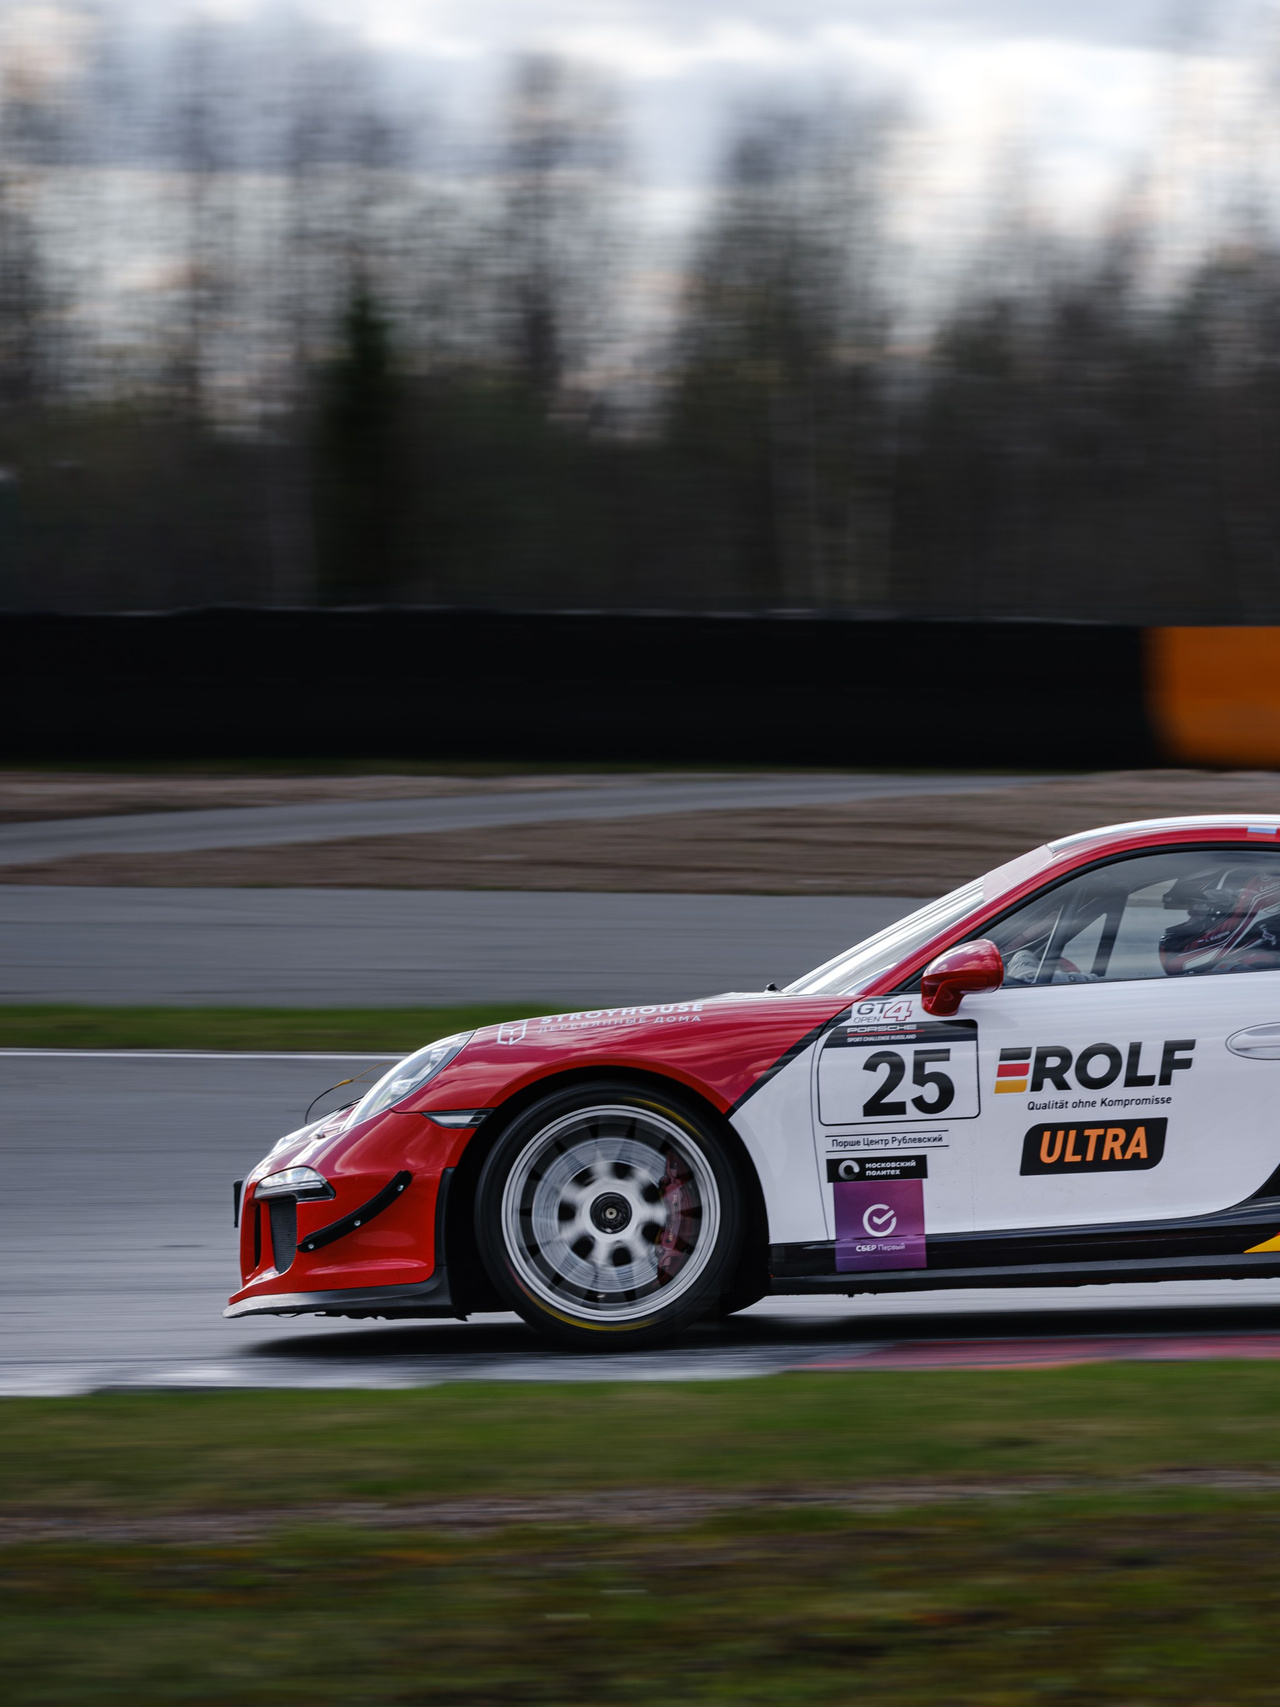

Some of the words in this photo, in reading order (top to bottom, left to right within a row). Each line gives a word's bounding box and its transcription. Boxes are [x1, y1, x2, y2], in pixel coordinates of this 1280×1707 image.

[540, 1003, 704, 1025] STROYHOUSE
[853, 1016, 881, 1024] OPEN
[857, 1001, 912, 1022] GT4
[536, 1015, 650, 1034] ДЕРЕВЯННЫЕ
[652, 1014, 702, 1024] ДОМА
[847, 1024, 917, 1034] PORSCHE
[1030, 1039, 1197, 1093] ROLF
[862, 1048, 955, 1117] 25
[1027, 1099, 1069, 1111] Qualität
[1071, 1098, 1097, 1109] ohne
[1100, 1095, 1172, 1109] Kompromisse
[832, 1138, 861, 1148] Порше
[862, 1137, 890, 1147] Центр
[891, 1134, 944, 1145] Рублевский
[1039, 1126, 1149, 1164] ULTRA
[855, 1244, 877, 1252] СБЕР
[877, 1243, 906, 1252] Первый
